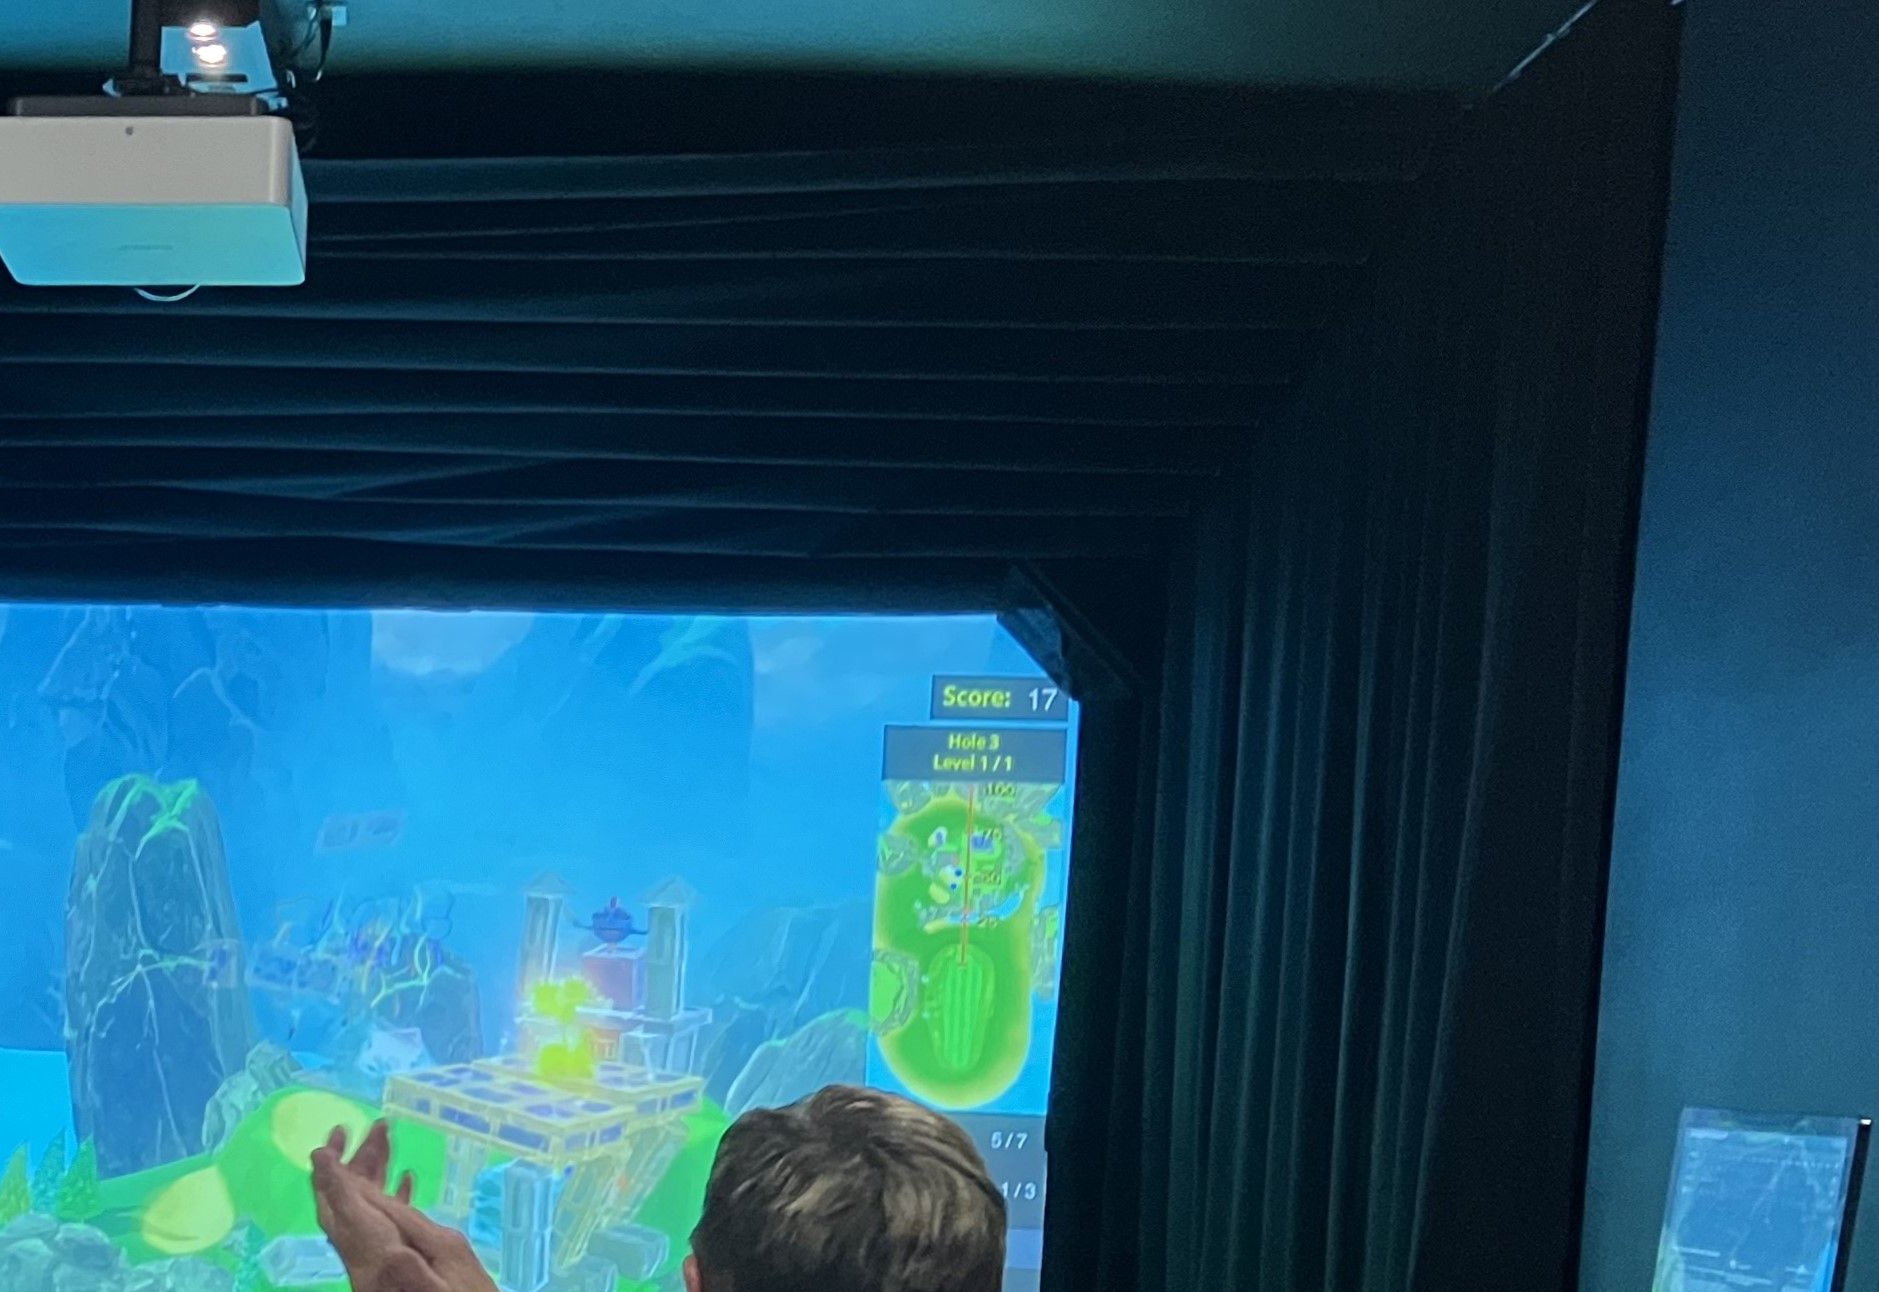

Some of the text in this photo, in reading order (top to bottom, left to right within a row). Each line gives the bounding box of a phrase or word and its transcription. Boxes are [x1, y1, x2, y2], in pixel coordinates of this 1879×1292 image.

[943, 684, 1058, 711] Score: 17
[948, 733, 986, 750] Hole
[933, 753, 975, 771] Level
